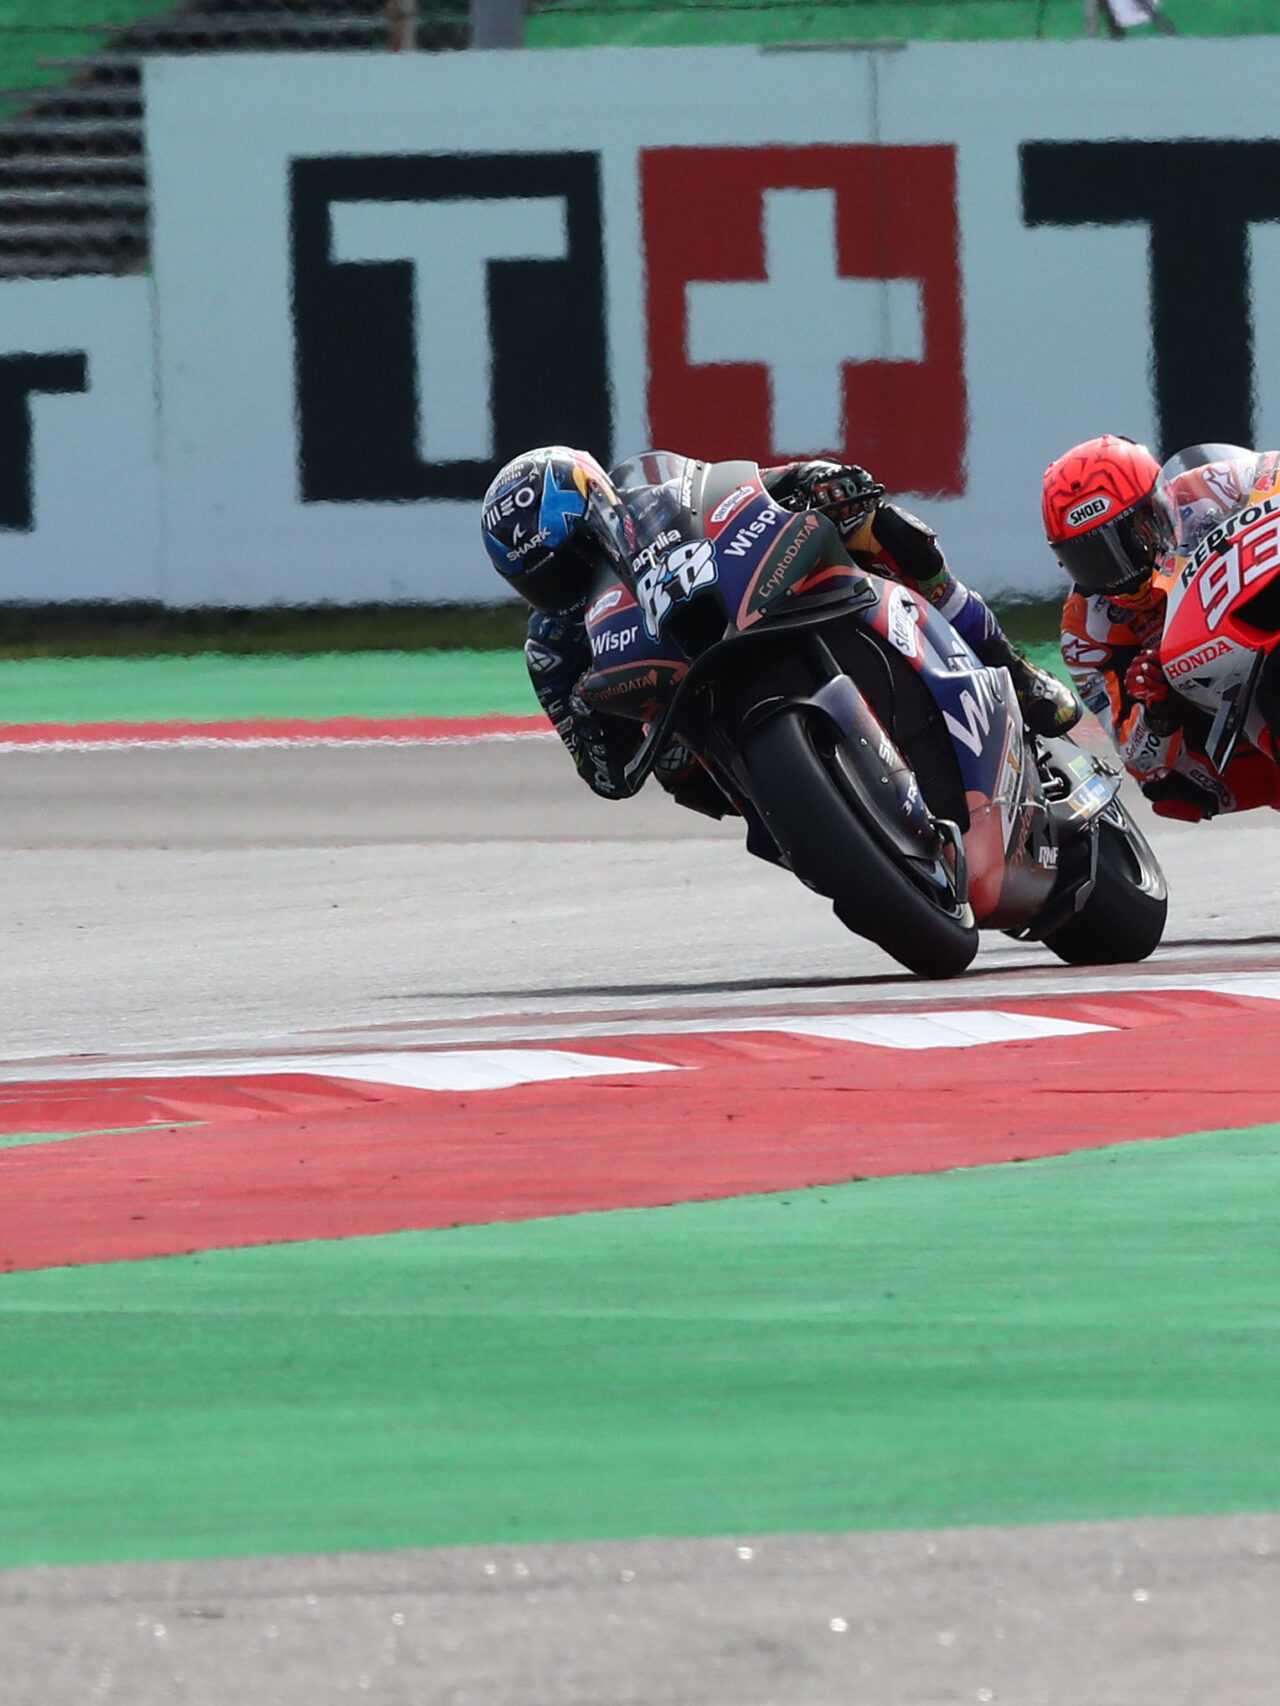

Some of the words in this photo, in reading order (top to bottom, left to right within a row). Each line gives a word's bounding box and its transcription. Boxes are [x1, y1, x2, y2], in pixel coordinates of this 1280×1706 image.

[723, 503, 782, 557] Wispr
[1069, 498, 1107, 525] SHOEI
[506, 526, 551, 562] SHARK
[632, 527, 682, 573] aprilia
[758, 521, 816, 598] CryptoDATA
[1181, 500, 1279, 589] REPSOL
[636, 539, 718, 639] 88
[590, 625, 638, 656] Wispr
[1166, 641, 1234, 679] HONDA
